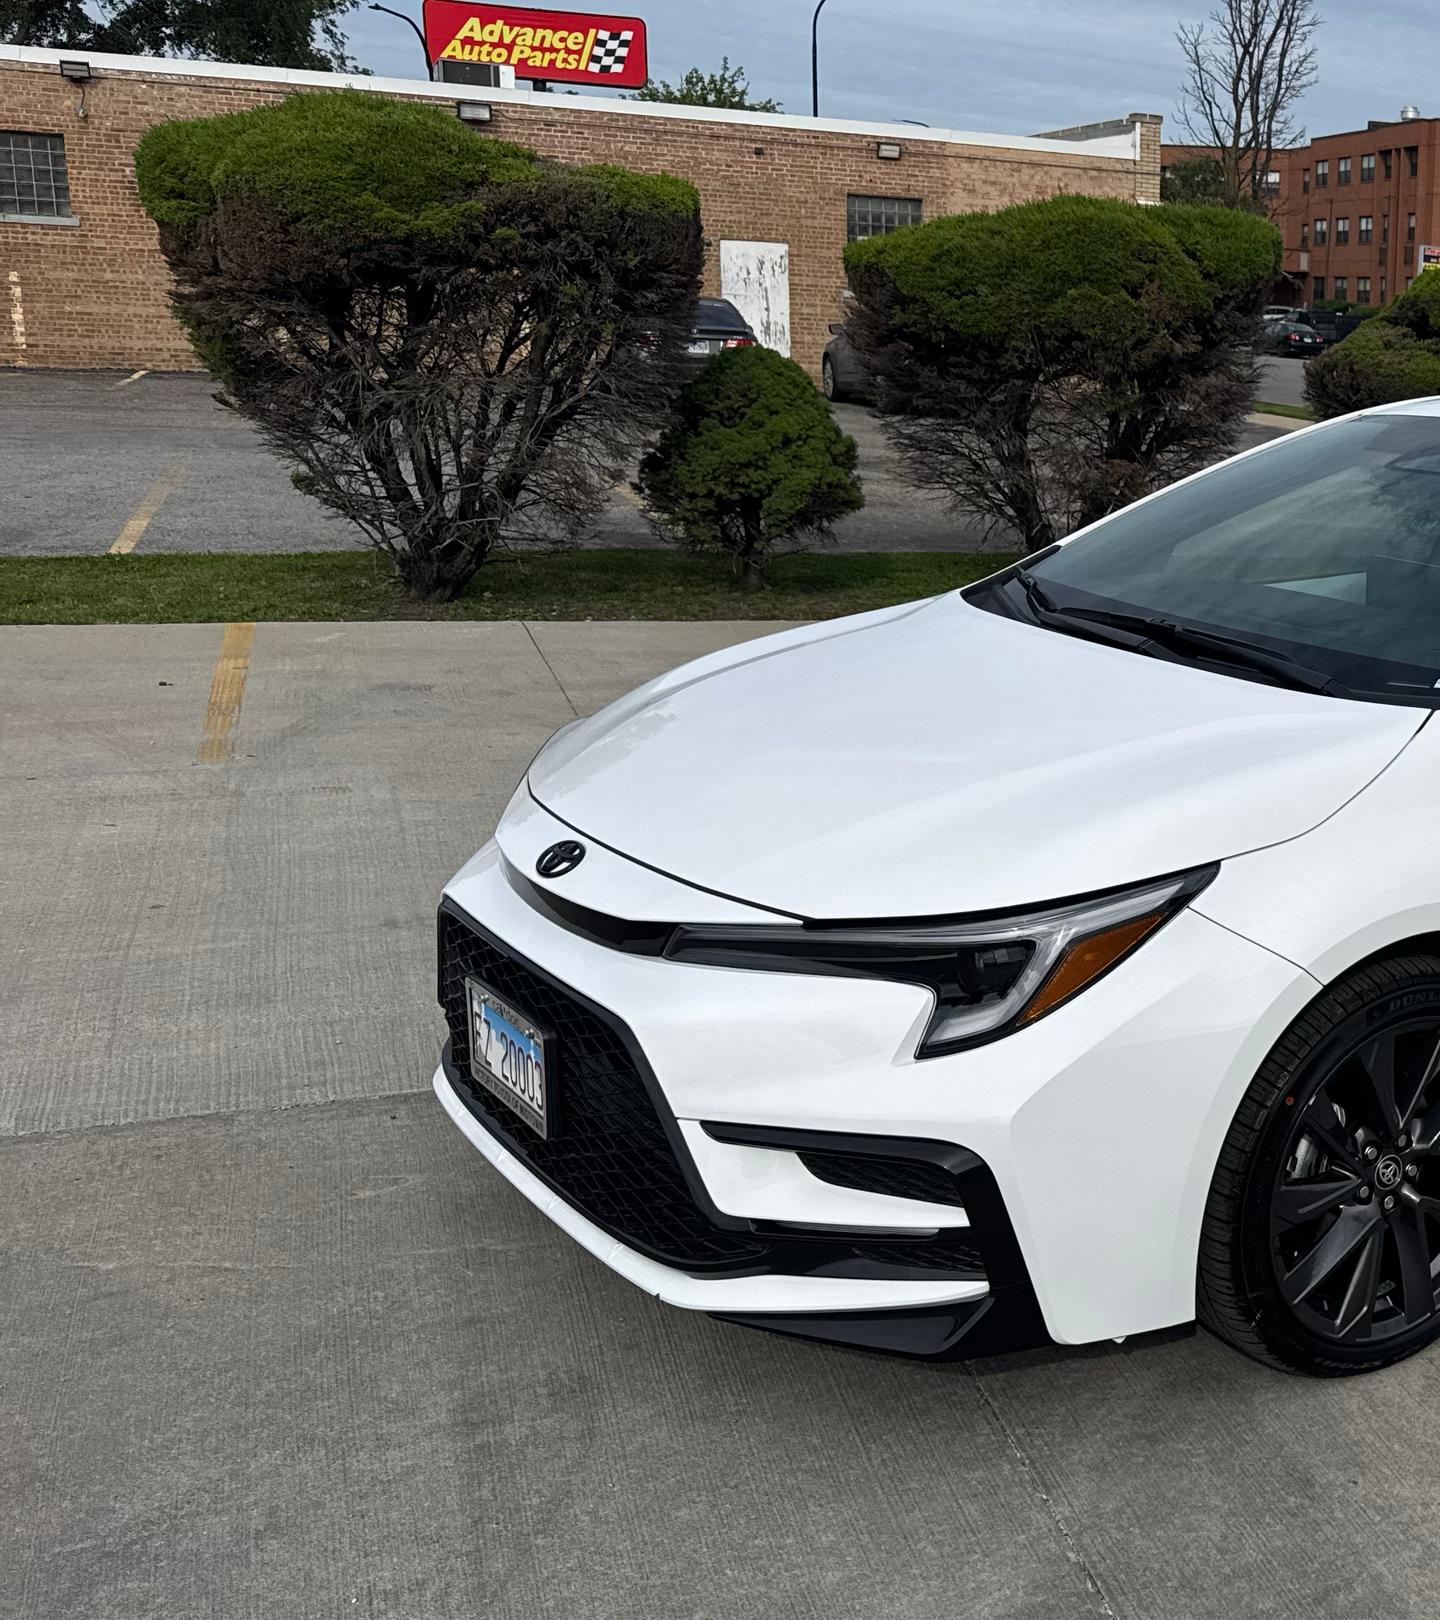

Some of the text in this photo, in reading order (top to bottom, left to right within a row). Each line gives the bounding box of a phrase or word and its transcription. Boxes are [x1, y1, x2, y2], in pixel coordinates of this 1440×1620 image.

[454, 17, 585, 50] Advance
[440, 39, 581, 70] Auto Parts
[501, 1031, 544, 1112] 20003
